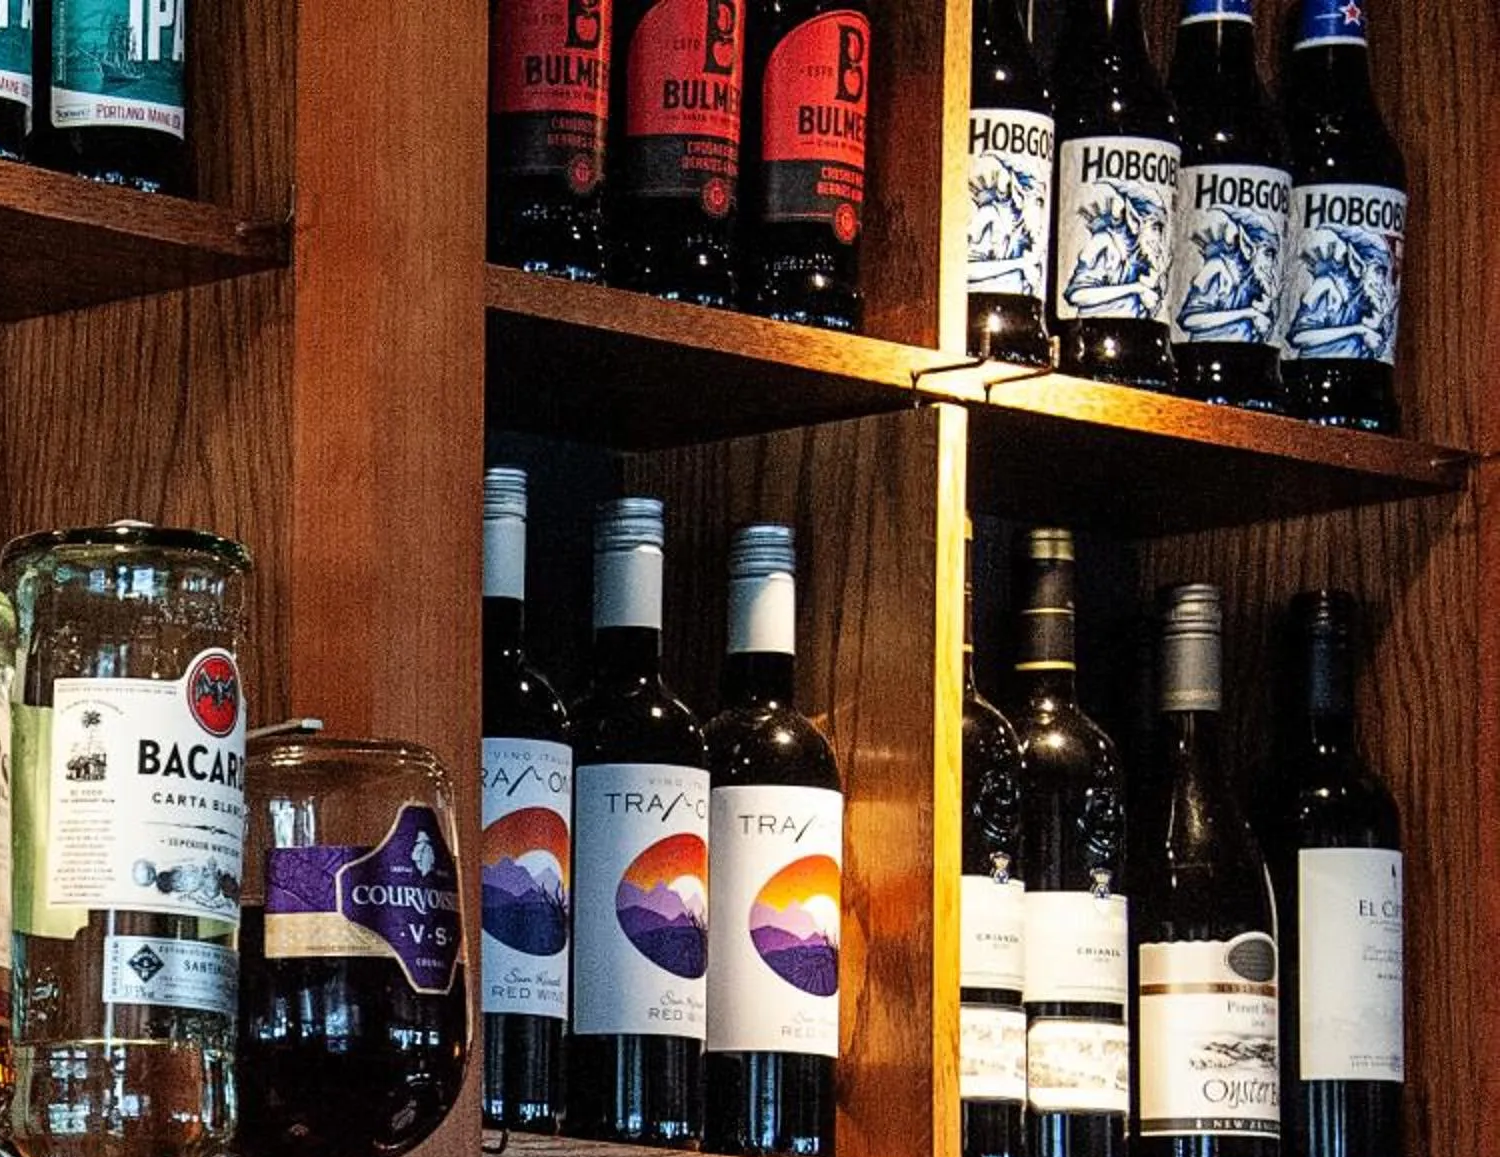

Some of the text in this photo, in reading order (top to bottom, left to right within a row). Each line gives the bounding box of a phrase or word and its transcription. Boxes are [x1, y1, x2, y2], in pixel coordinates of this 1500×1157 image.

[95, 103, 145, 120] PORTLAND
[969, 118, 1053, 162] HOBGO
[152, 791, 207, 809] CARTA
[1359, 899, 1378, 917] EL
[491, 985, 531, 1000] RED
[649, 1008, 683, 1021] RED
[1213, 1118, 1245, 1129] NEW
